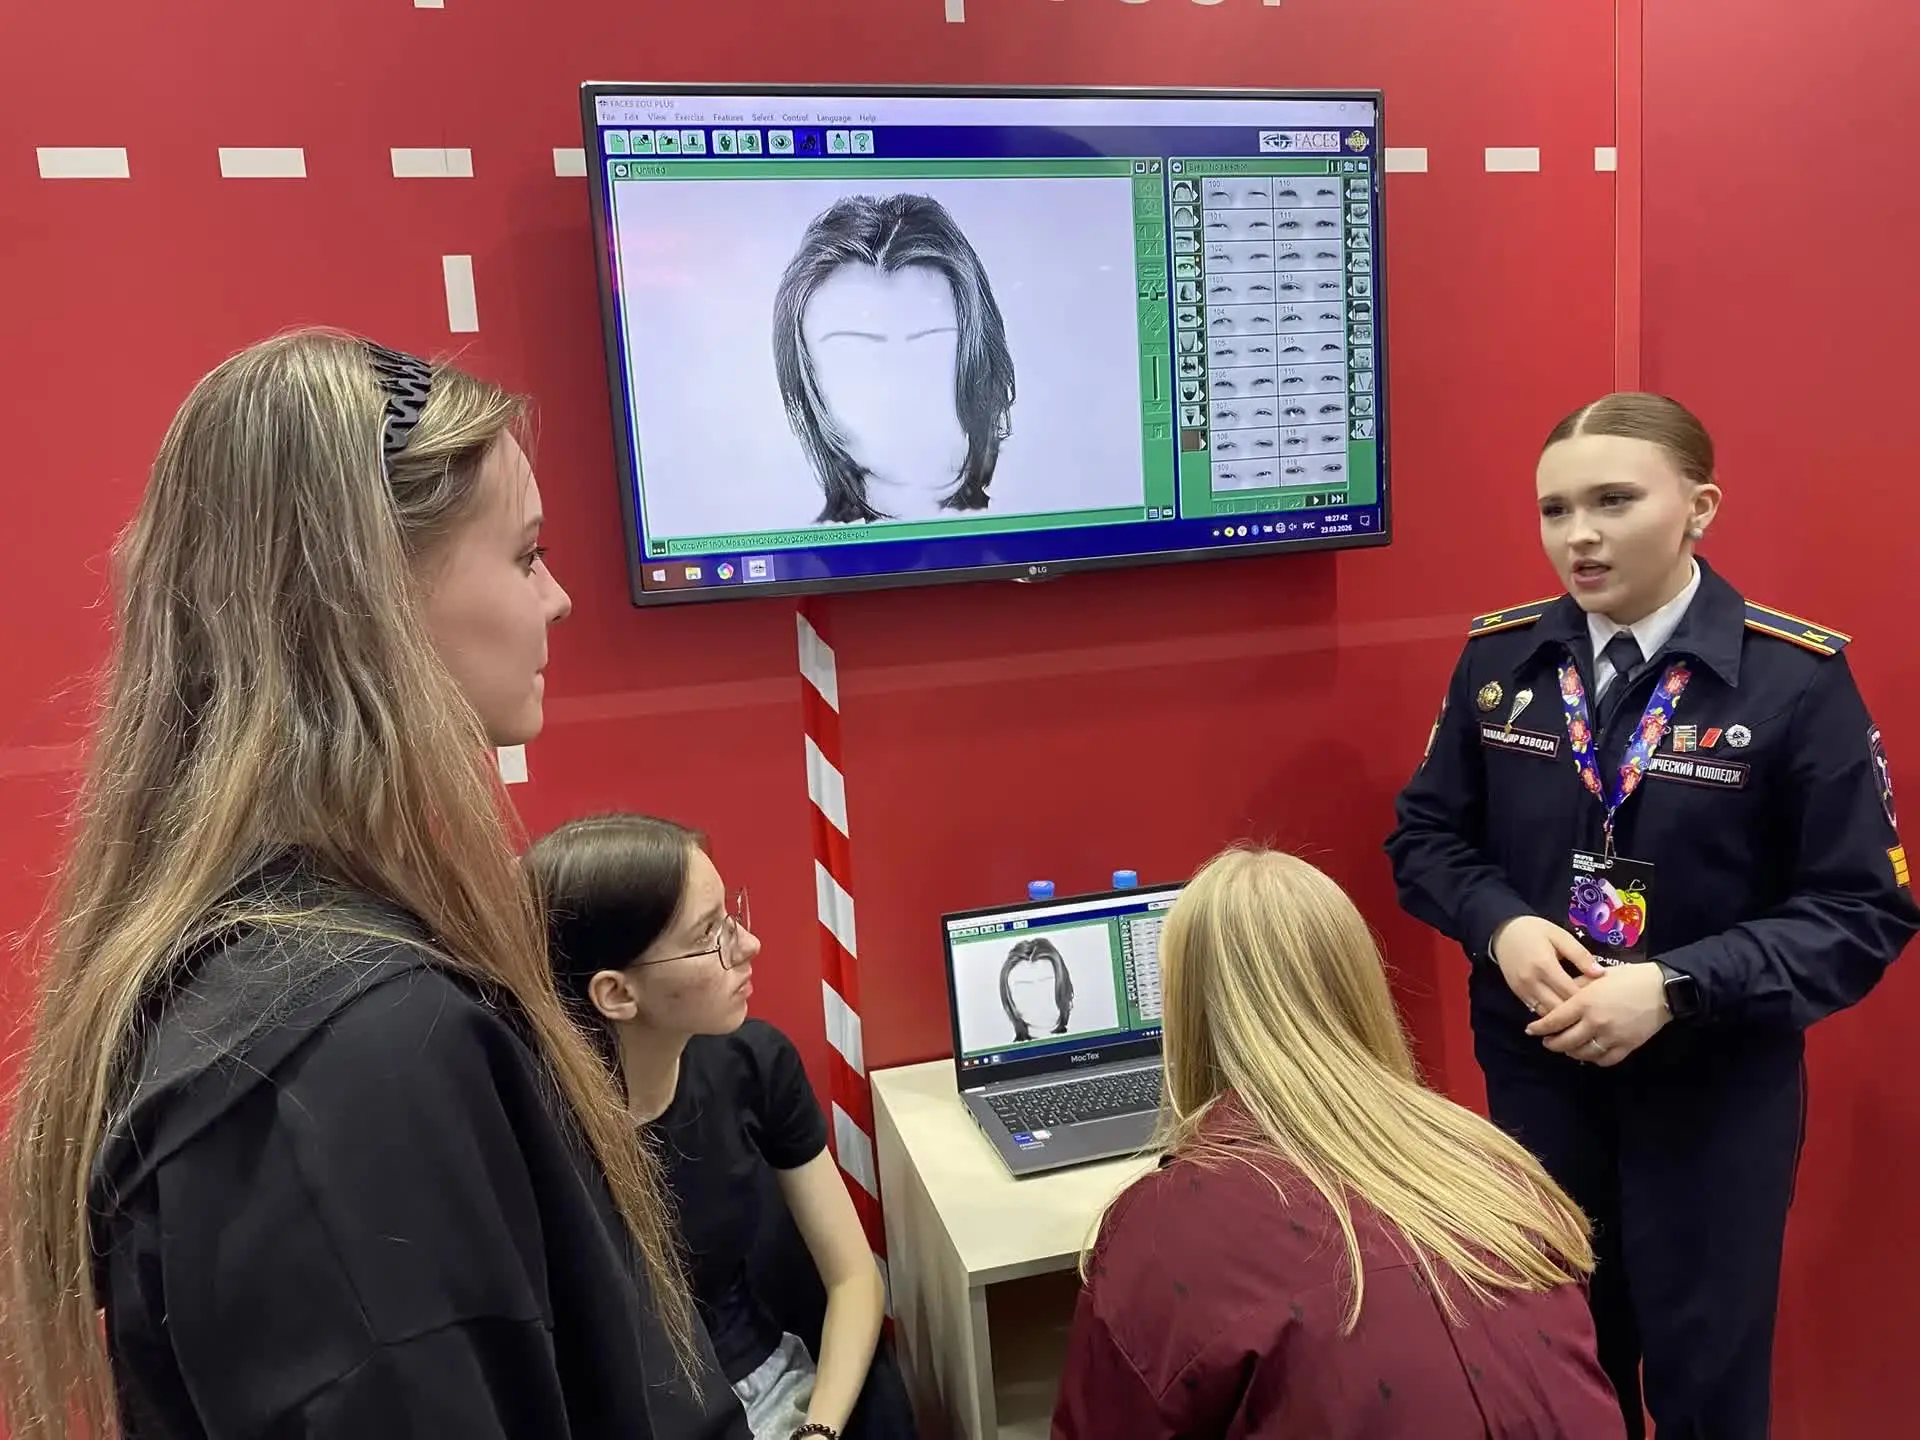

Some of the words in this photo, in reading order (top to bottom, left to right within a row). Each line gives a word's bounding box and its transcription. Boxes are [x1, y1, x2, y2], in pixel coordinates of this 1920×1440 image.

[601, 112, 616, 121] File
[624, 112, 639, 121] Edit
[647, 112, 667, 121] View
[674, 112, 704, 121] Exercise
[713, 113, 743, 121] Features
[751, 113, 774, 121] Select
[781, 113, 809, 121] Control
[816, 113, 852, 123] Language
[859, 113, 877, 122] Help
[1294, 133, 1338, 148] FACES
[1302, 522, 1316, 530] РУС
[1037, 566, 1047, 574] LG
[1519, 735, 1555, 752] ВЗВОДА
[1695, 764, 1742, 784] КОЛЛЕДЖ
